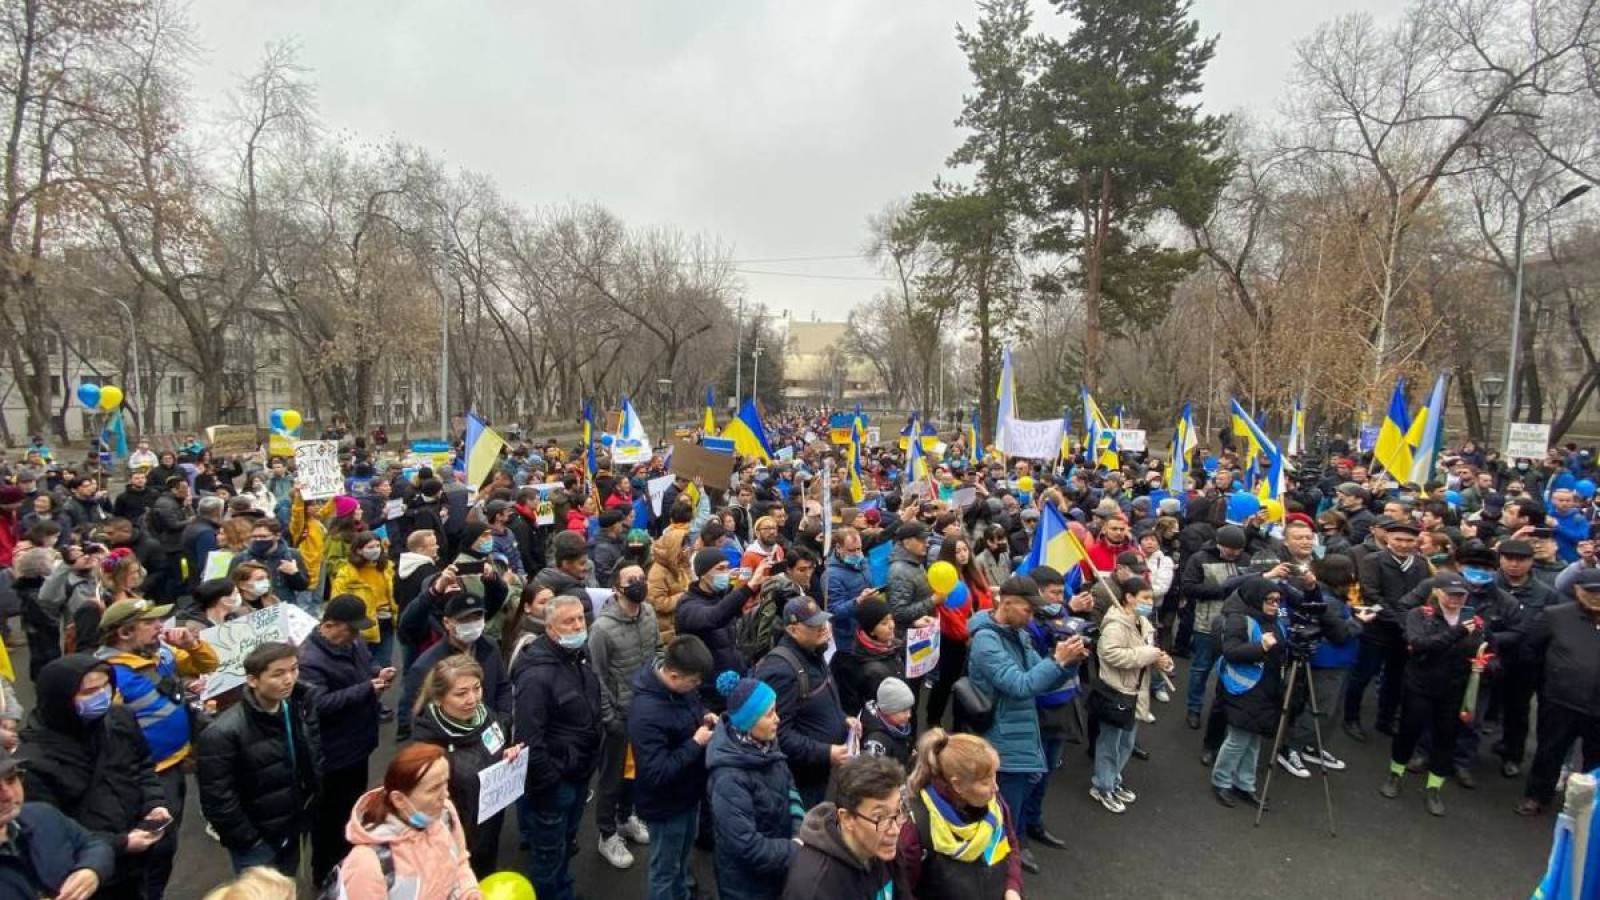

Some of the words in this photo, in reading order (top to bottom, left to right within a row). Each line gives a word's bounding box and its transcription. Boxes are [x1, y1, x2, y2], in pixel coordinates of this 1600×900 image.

[1013, 425, 1050, 439] STOP
[297, 443, 337, 458] STOP
[299, 459, 335, 476] PUTIN
